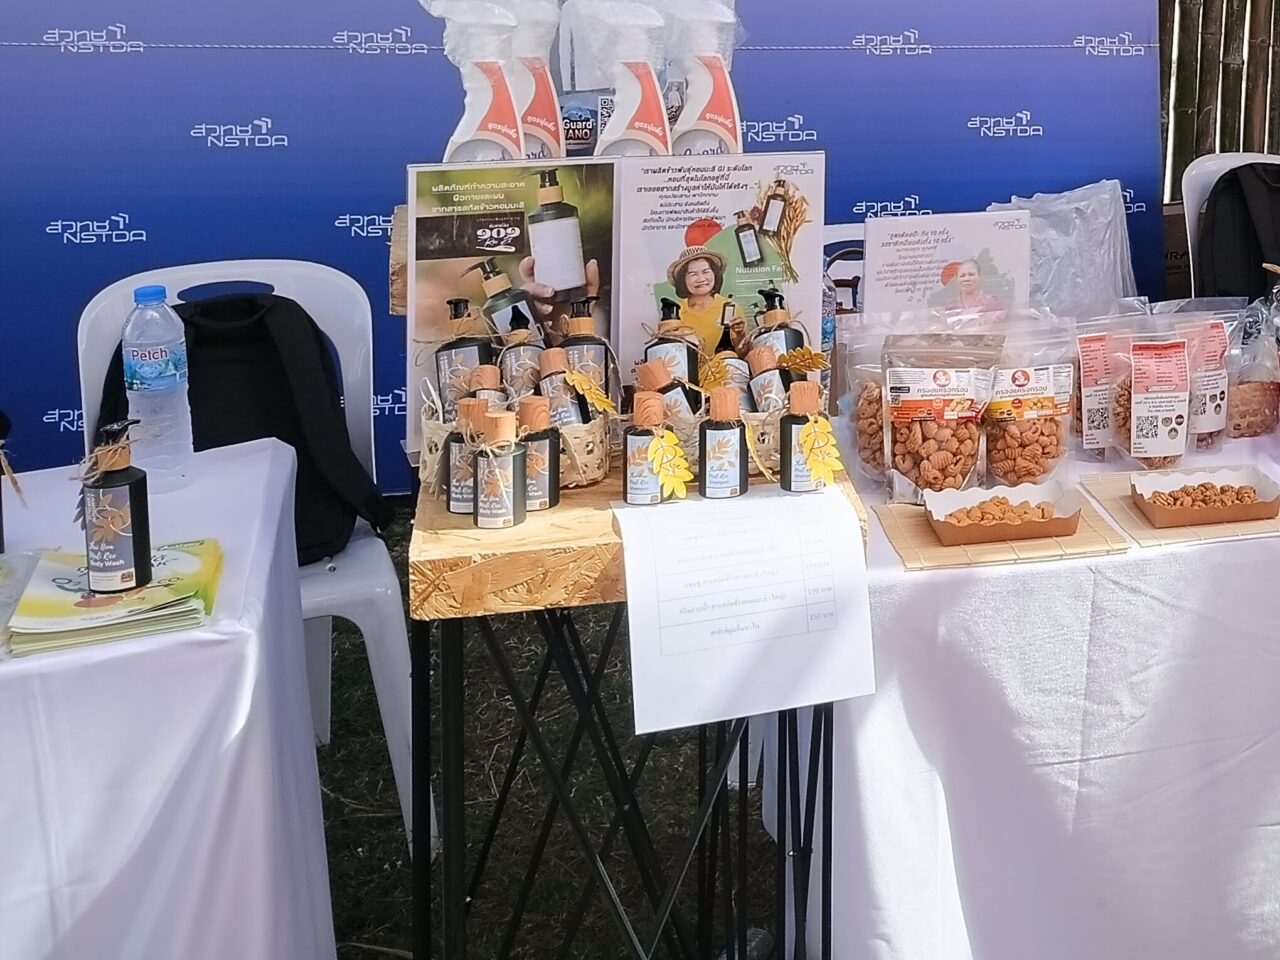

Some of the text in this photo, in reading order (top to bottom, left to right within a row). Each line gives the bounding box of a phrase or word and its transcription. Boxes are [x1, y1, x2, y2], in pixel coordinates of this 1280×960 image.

[981, 126, 1042, 136] NSTDA
[207, 135, 288, 147] NSTDA
[748, 132, 817, 141] NSTDA
[351, 226, 393, 237] NST
[64, 231, 146, 243] NSTDA
[736, 266, 770, 274] Nutrition
[131, 347, 168, 361] Petch
[104, 559, 125, 567] Wash
[809, 613, 822, 621] 150
